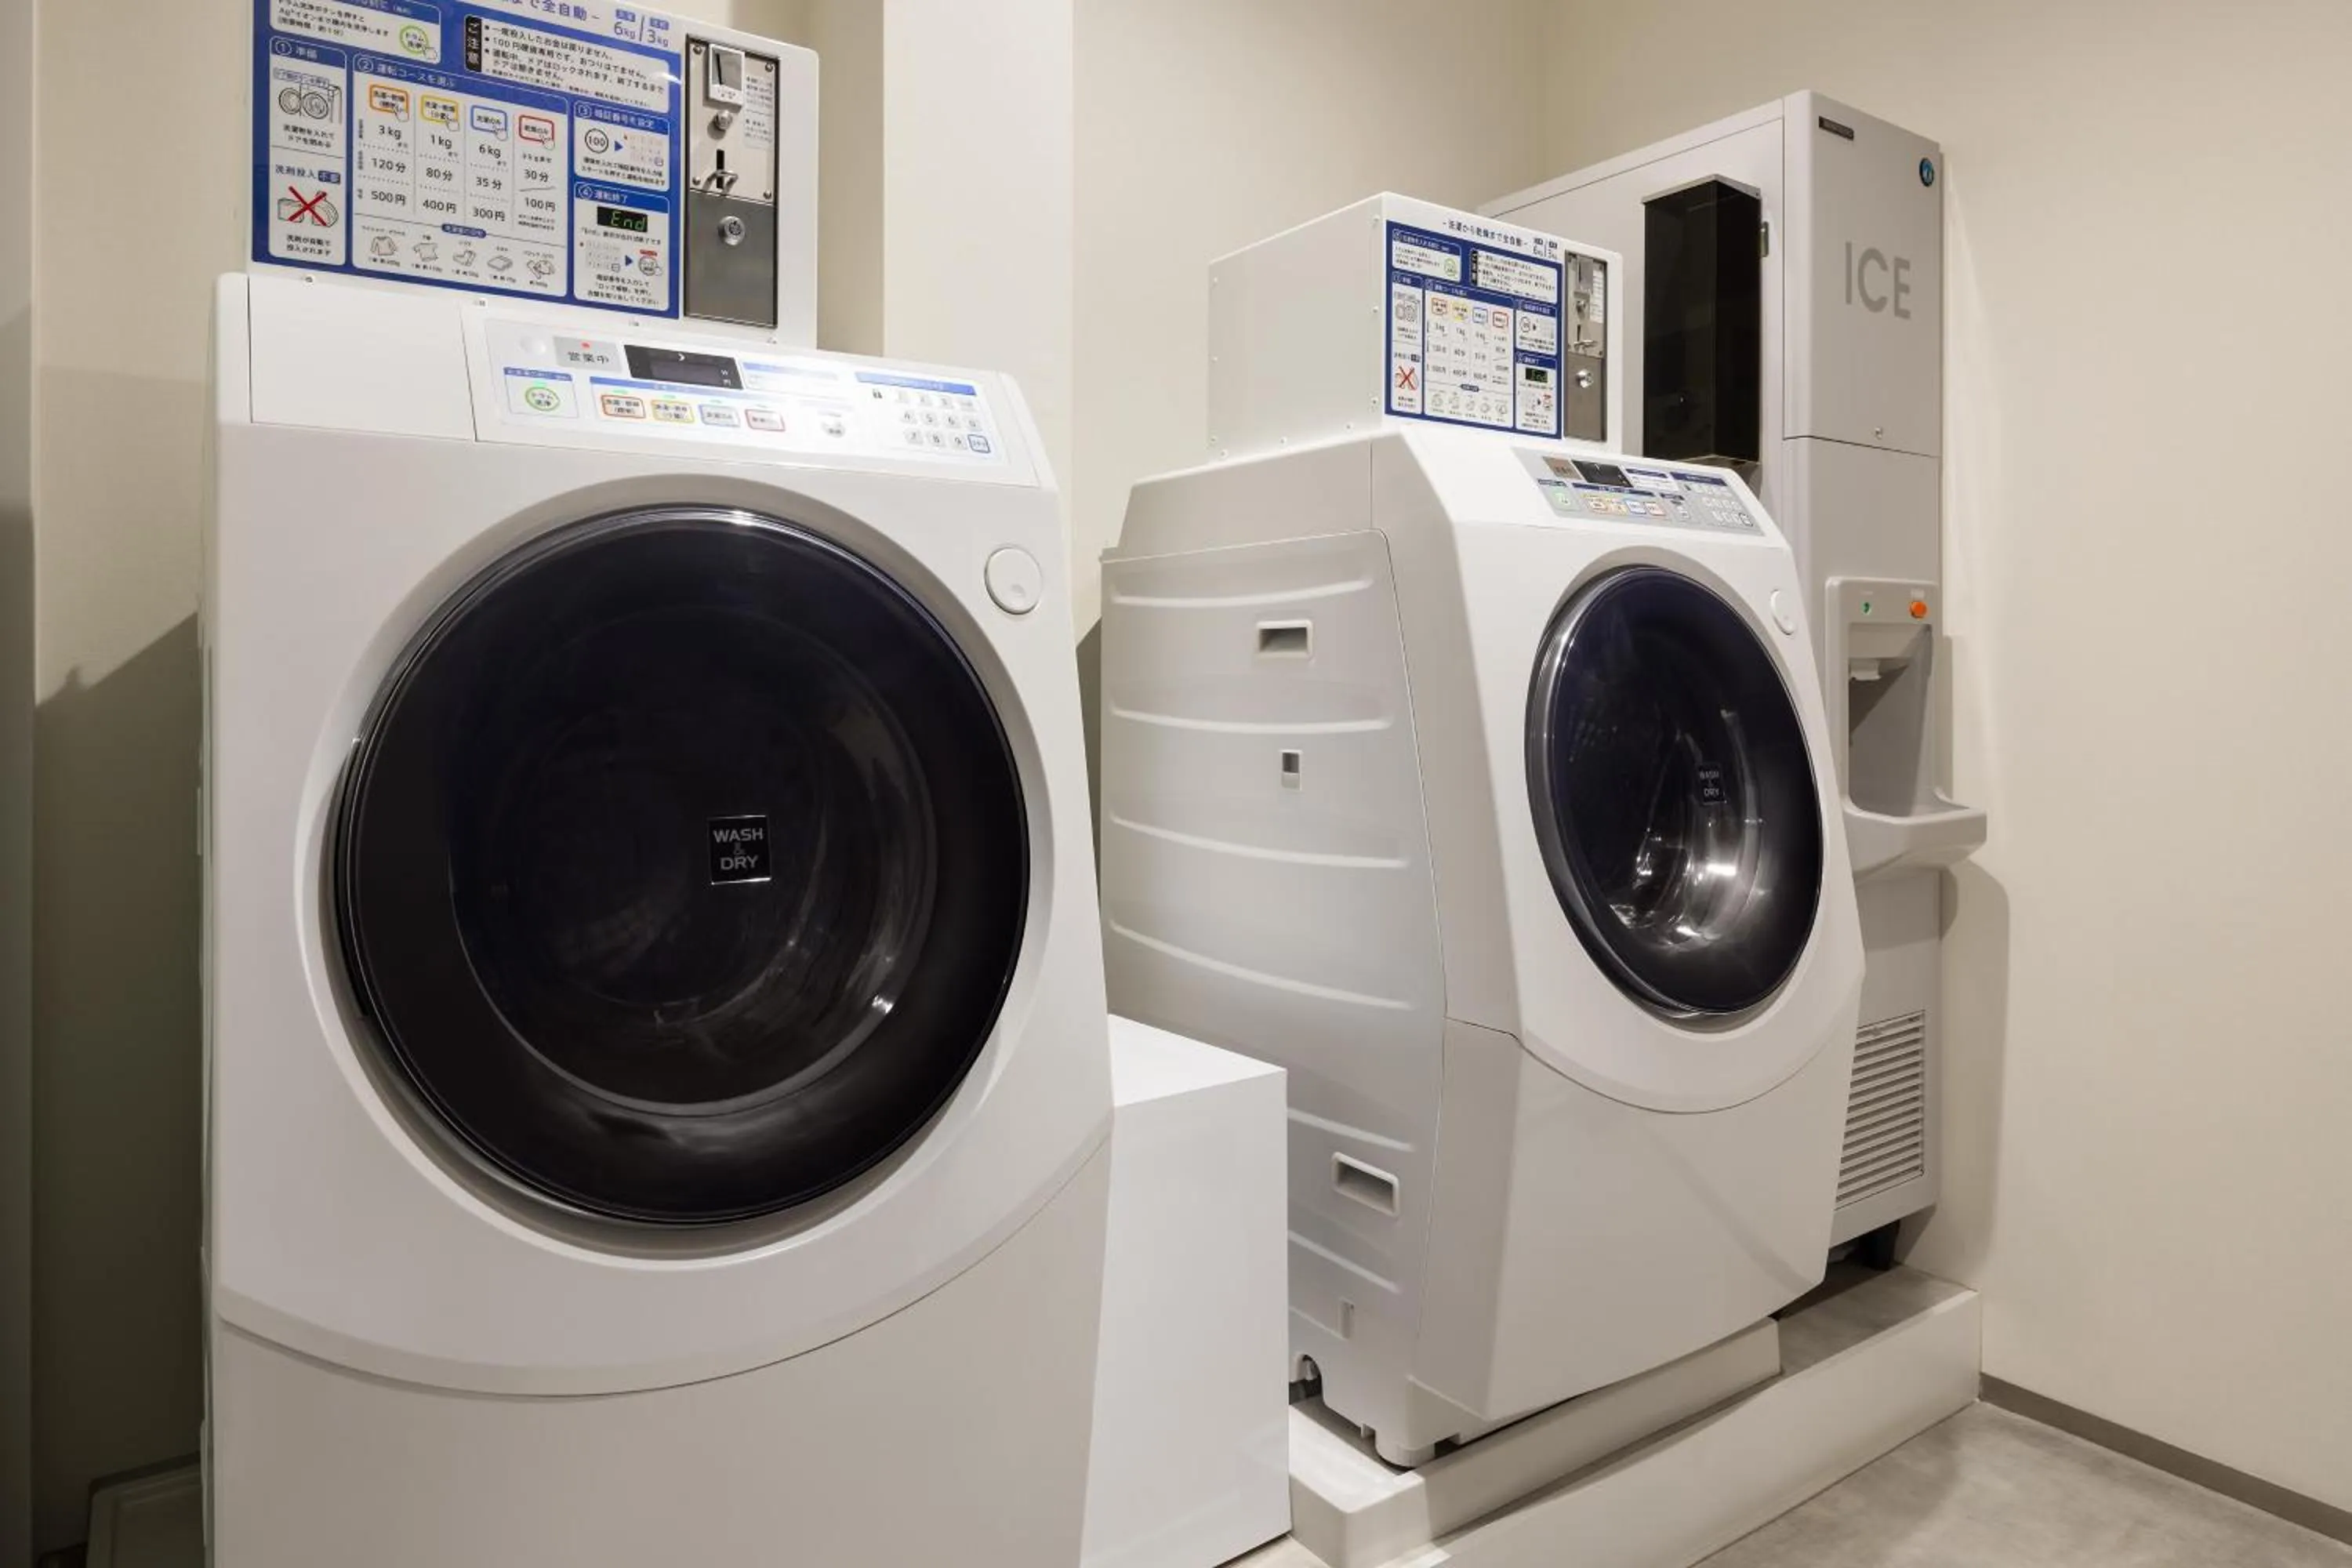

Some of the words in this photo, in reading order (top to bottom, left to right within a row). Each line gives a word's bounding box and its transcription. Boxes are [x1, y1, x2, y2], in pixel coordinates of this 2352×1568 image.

[614, 21, 636, 39] 6kg
[647, 29, 669, 47] 3kg
[426, 167, 453, 182] 80分
[524, 169, 550, 183] 30分
[476, 176, 503, 191] 35分
[371, 191, 407, 208] 500円
[423, 199, 457, 215] 400円
[524, 198, 557, 212] 100円
[473, 207, 506, 222] 300円
[611, 211, 646, 231] End
[1845, 241, 1911, 319] ICE
[567, 350, 610, 365] 営業中
[713, 828, 764, 843] WASH
[720, 855, 758, 870] DRY
